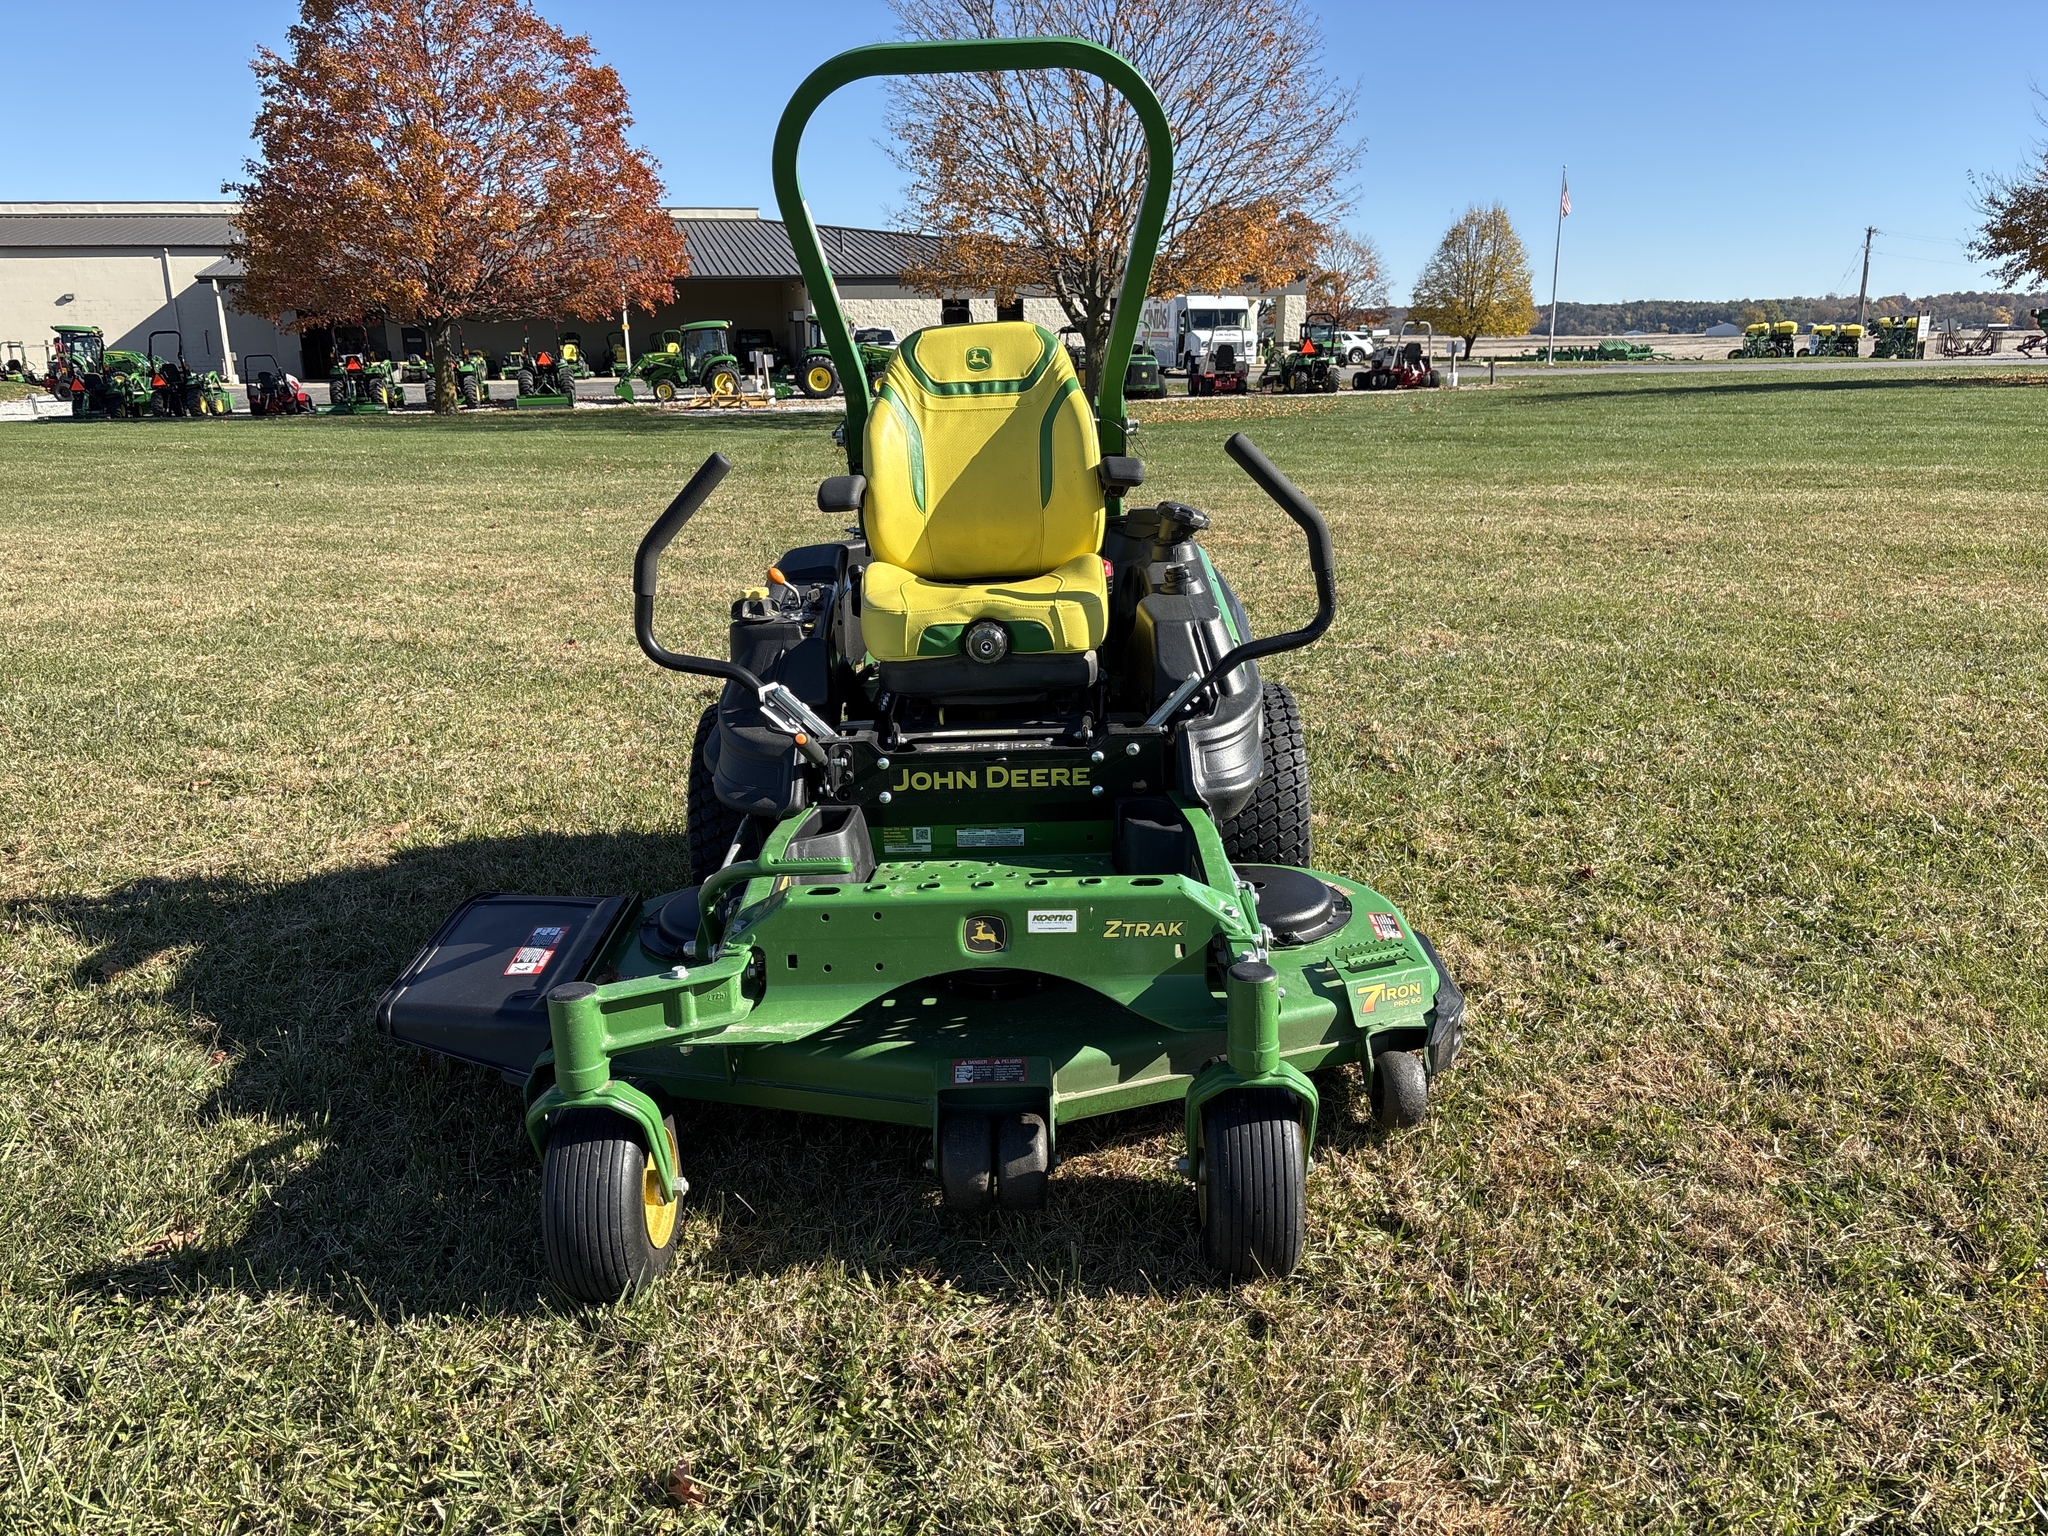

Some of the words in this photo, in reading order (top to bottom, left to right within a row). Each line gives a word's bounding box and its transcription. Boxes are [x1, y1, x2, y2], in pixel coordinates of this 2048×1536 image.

[893, 768, 977, 792] JOHN
[986, 766, 1091, 789] DEERE
[1102, 920, 1185, 938] ZTRAK
[1393, 999, 1410, 1008] PRO
[1410, 996, 1422, 1004] 60
